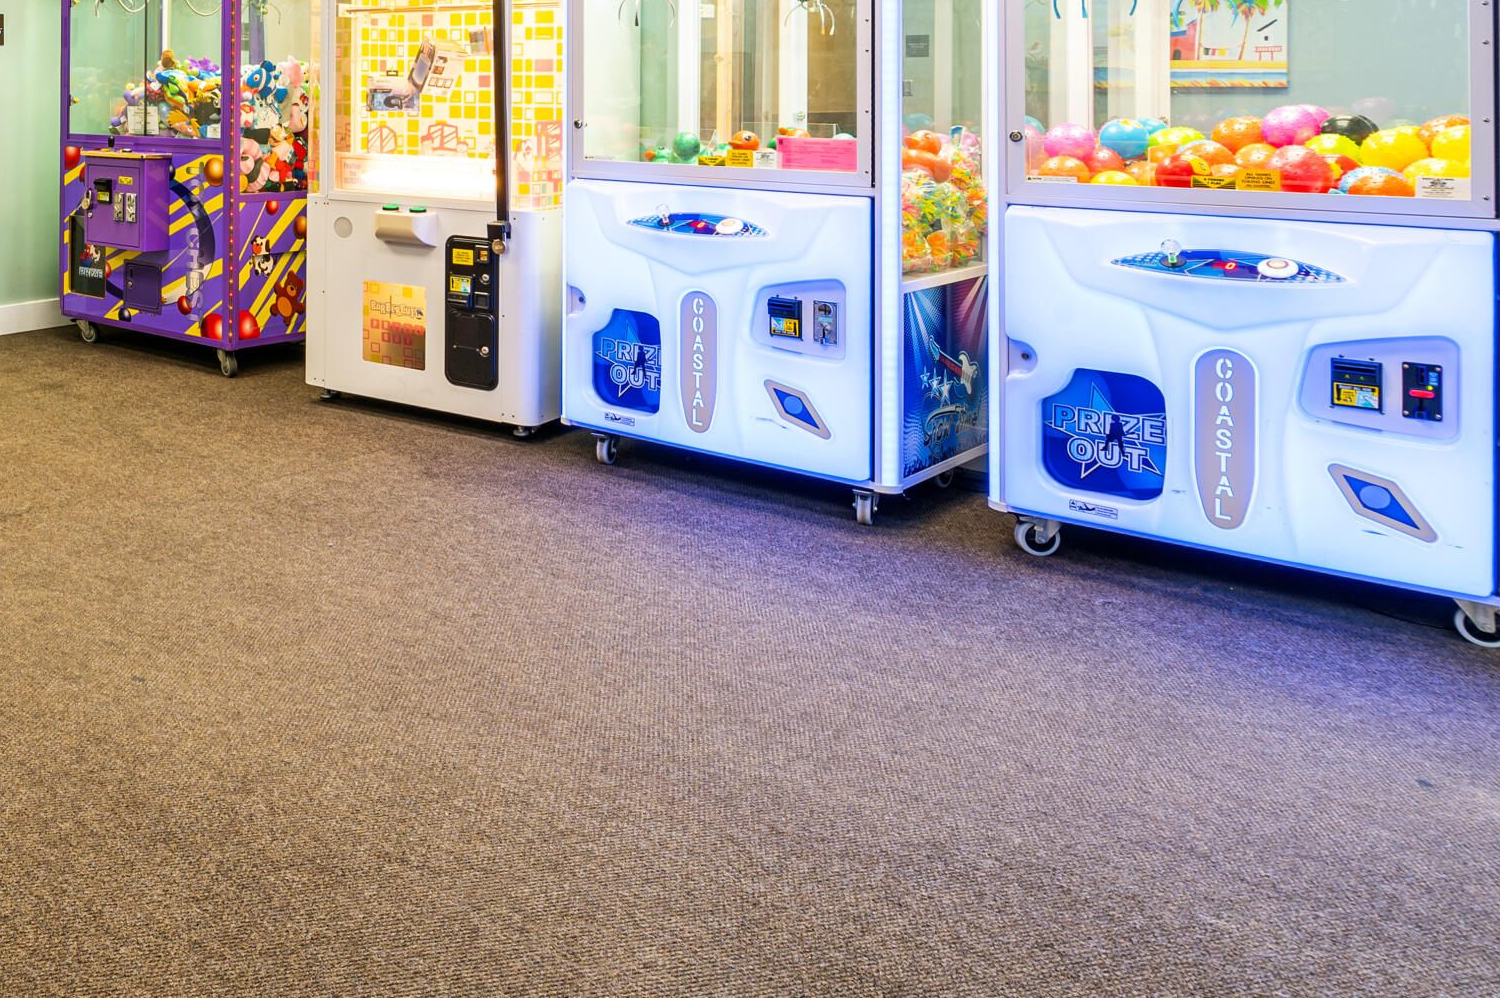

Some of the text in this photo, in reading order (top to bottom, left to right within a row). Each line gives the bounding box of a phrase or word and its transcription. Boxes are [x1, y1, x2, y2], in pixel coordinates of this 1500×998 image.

[1226, 261, 1237, 270] 0
[610, 364, 661, 391] OUT
[692, 297, 705, 426] COASTAL
[1052, 403, 1166, 445] PRIZE
[1215, 357, 1234, 522] COASTAL
[1067, 438, 1148, 473] OUT
